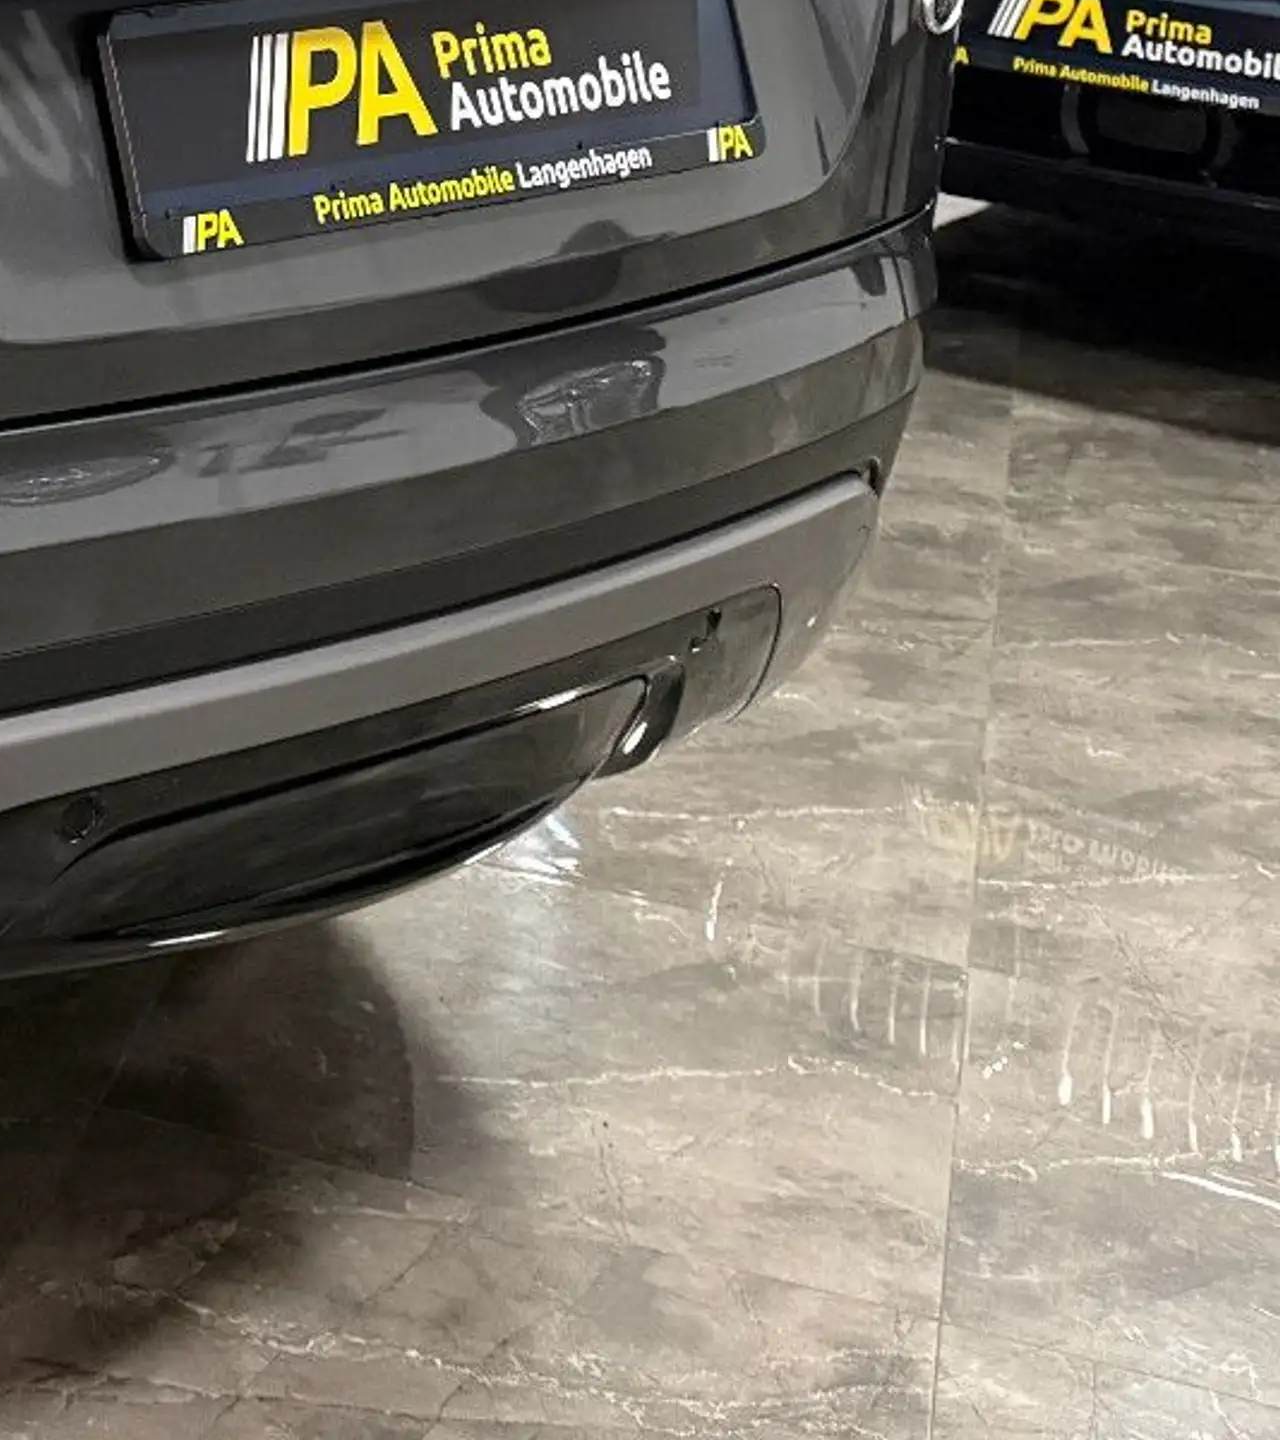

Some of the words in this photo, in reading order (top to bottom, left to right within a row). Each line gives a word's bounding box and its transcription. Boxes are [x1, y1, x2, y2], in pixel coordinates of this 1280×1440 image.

[432, 22, 552, 79] Prima
[1125, 8, 1212, 45] Prima
[953, 46, 970, 65] A
[288, 21, 438, 157] PA
[450, 51, 672, 131] Automobile
[1013, 56, 1057, 79] Prima
[1059, 64, 1150, 95] Automobile
[1151, 79, 1260, 111] Langenhagen
[717, 124, 753, 162] PA
[313, 192, 384, 225] Prima
[388, 165, 515, 213] Automobile
[516, 145, 653, 191] Langenhagen
[196, 209, 243, 251] PA
